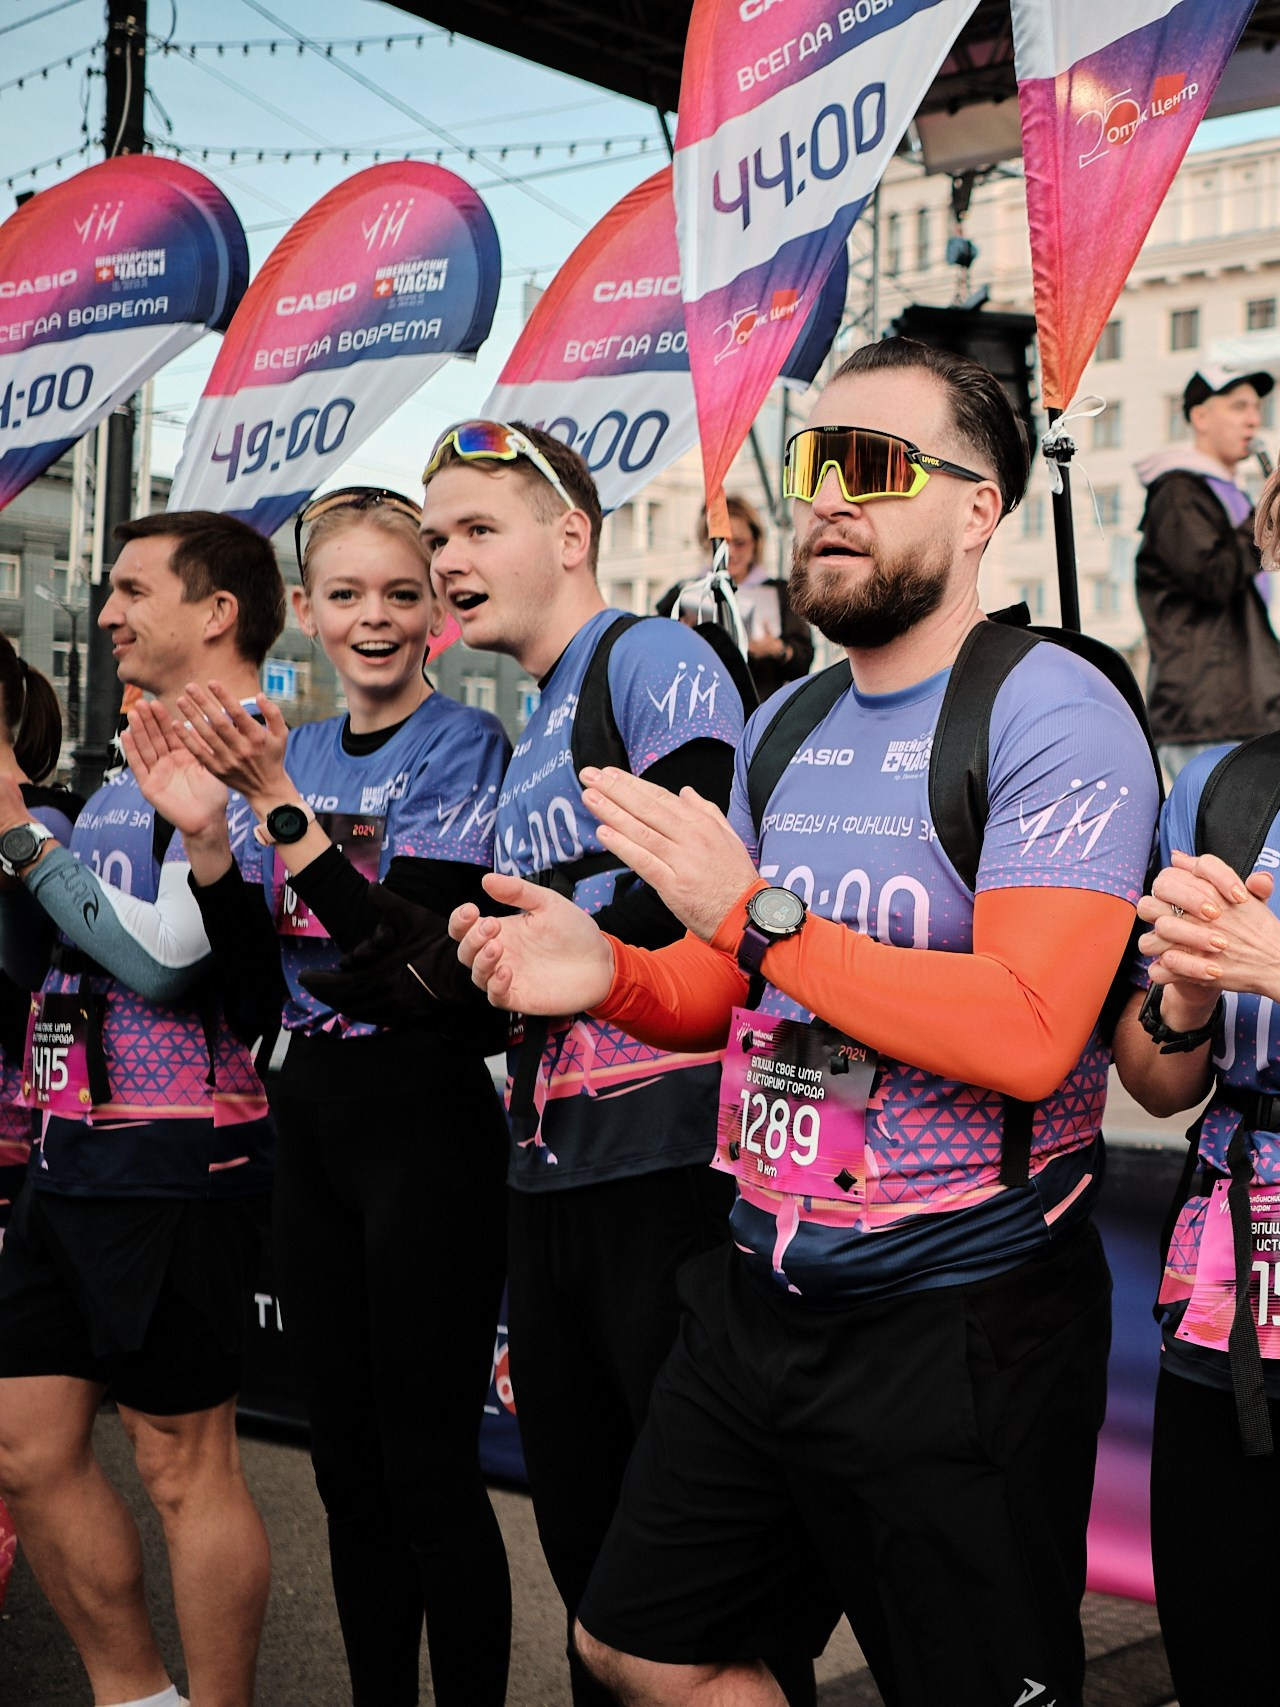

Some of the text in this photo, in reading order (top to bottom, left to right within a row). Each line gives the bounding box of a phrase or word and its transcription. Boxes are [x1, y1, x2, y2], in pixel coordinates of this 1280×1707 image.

[737, 22, 833, 92] ВСЕГДА
[1151, 83, 1198, 117] Центр
[713, 82, 886, 231] 44:00
[114, 259, 166, 280] ЧАСЫ
[393, 271, 448, 295] ЧАСЫ
[68, 296, 168, 328] ВОВРЕМЯ
[276, 282, 356, 316] CASIO
[254, 318, 441, 371] ВСЕГДА ВОВРЕМЯ
[563, 330, 689, 364] ВСЕГДА ВО
[211, 398, 355, 484] 49:00
[921, 455, 941, 467] uvex
[352, 824, 375, 837] 2024
[826, 815, 840, 834] К
[842, 816, 914, 837] ФИНИШУ
[32, 1046, 69, 1091] 1415
[746, 1070, 825, 1100] В ИСТОРИЮ ГОРОДА
[751, 1055, 823, 1083] ВПИШИ СВОЕ ИМЯ
[740, 1088, 821, 1166] 1289
